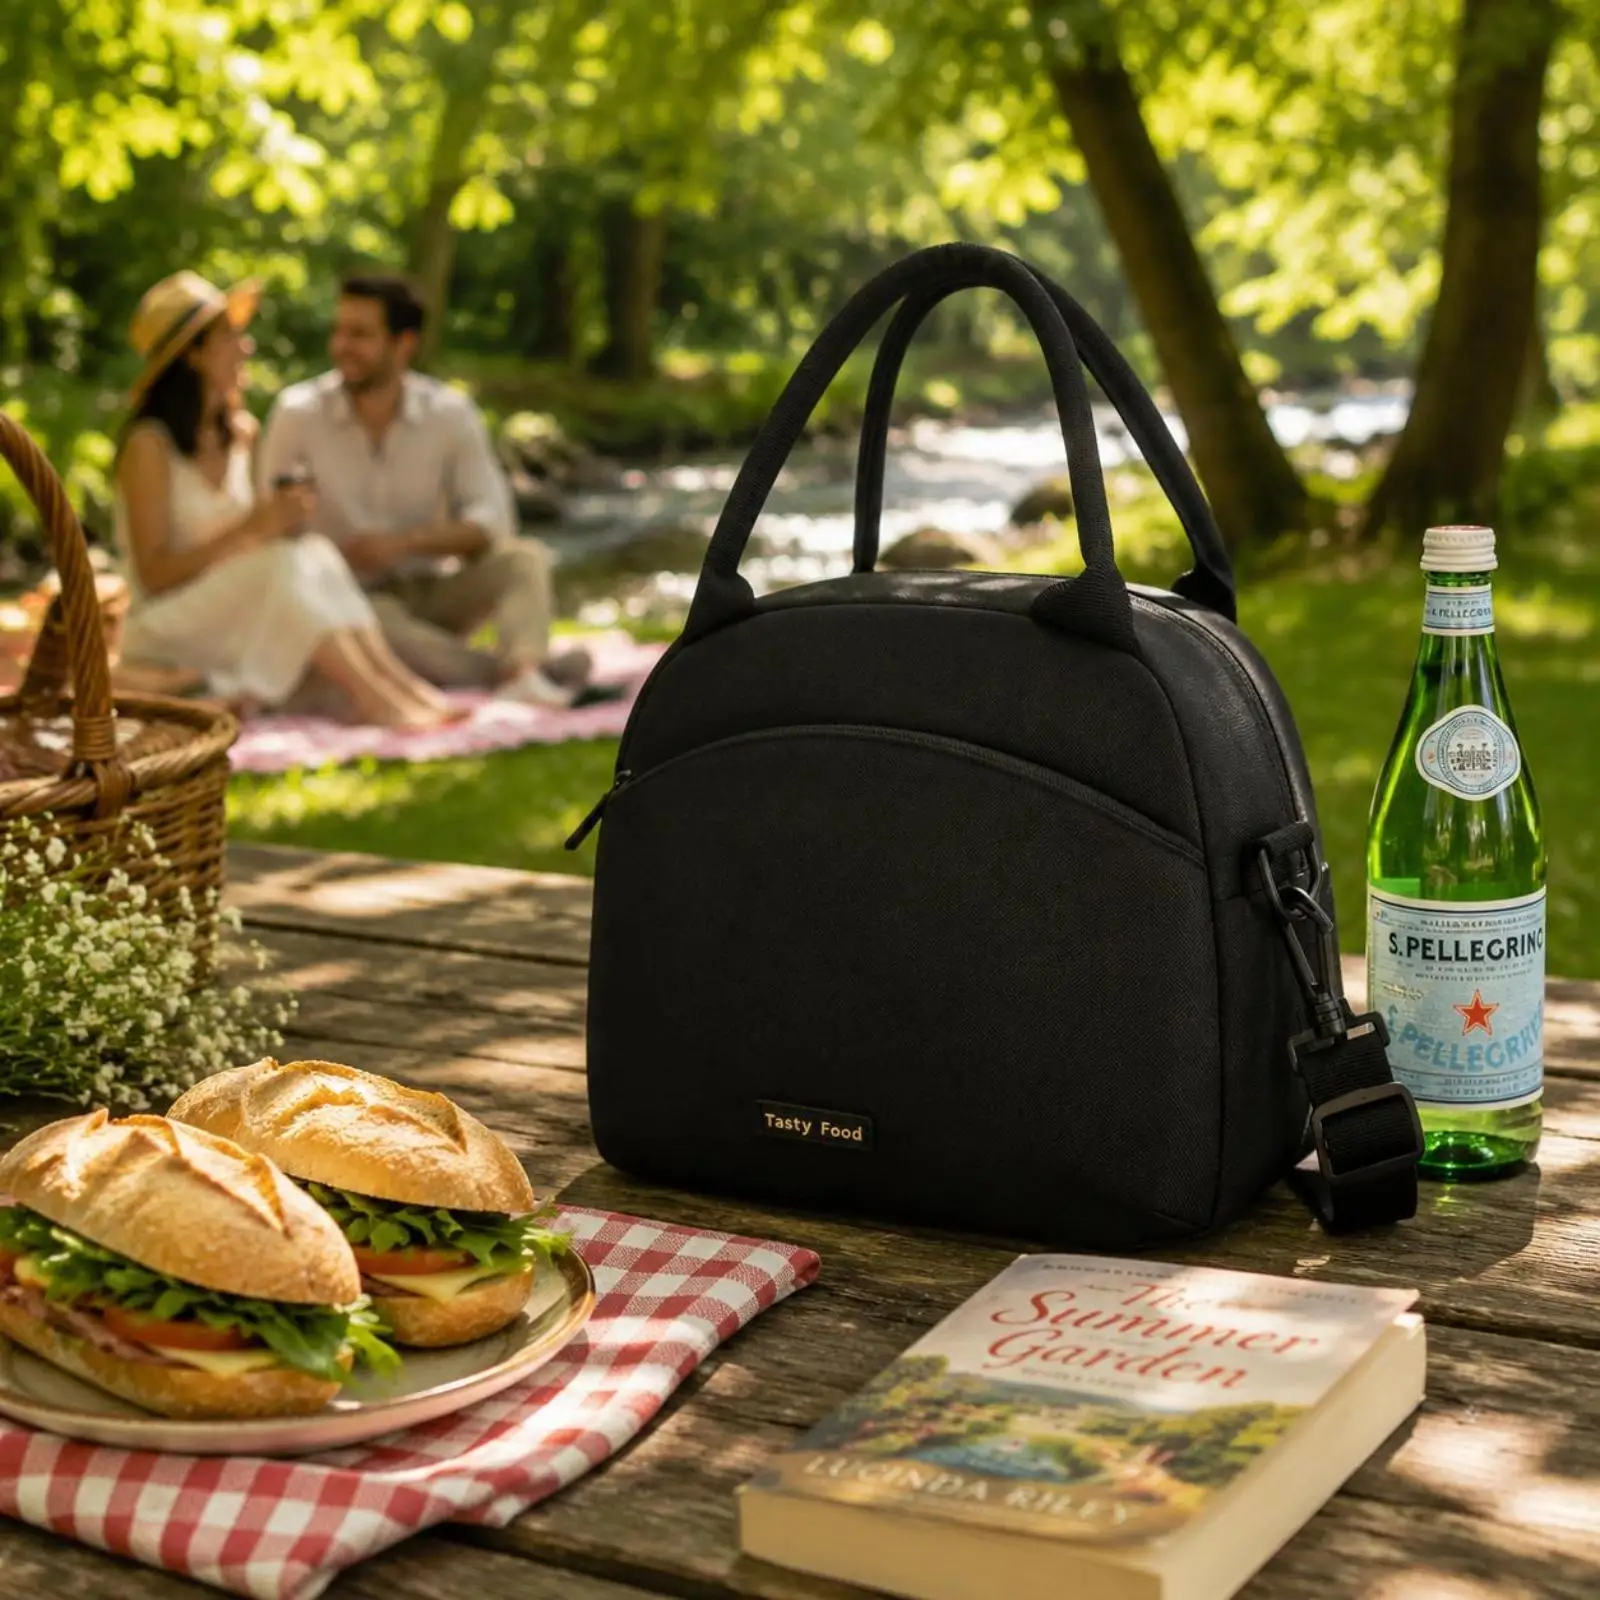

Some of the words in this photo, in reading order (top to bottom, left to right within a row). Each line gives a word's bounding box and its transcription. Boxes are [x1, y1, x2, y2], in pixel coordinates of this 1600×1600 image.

[764, 1112, 812, 1136] Tasty
[820, 1121, 863, 1141] Food
[991, 1289, 1320, 1354] Summer
[982, 1328, 1249, 1389] Garden
[803, 1455, 989, 1501] LUCINDA
